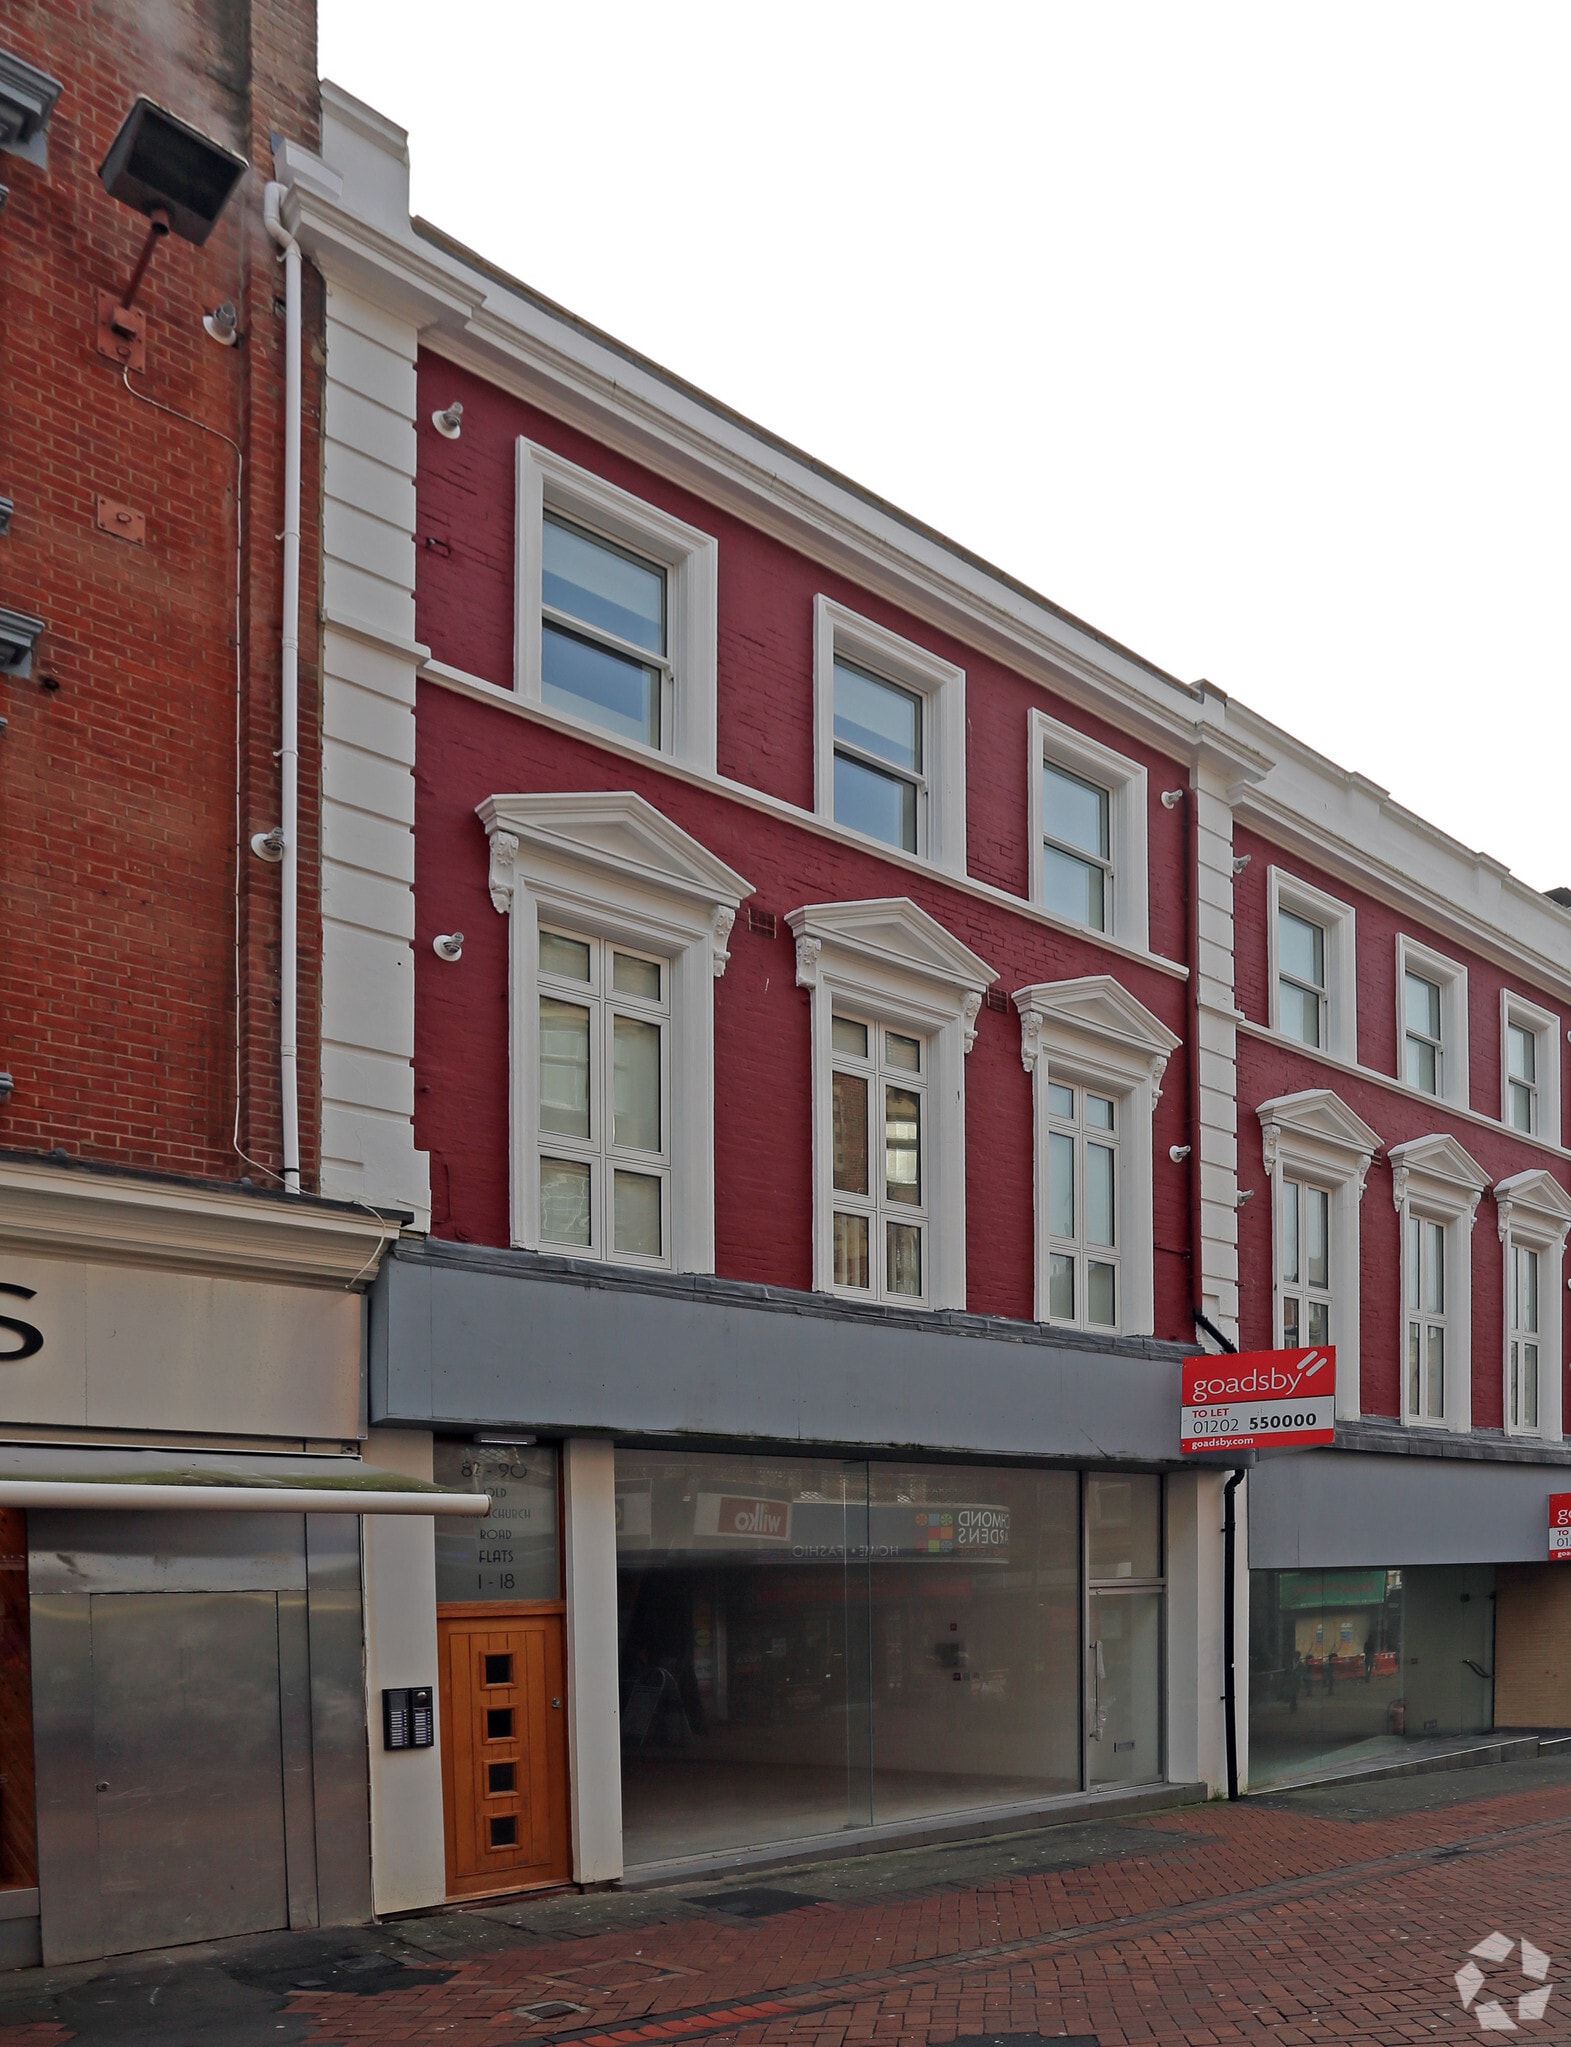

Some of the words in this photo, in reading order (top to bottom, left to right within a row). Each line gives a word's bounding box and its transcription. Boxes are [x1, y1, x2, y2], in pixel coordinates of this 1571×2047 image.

[1192, 1367, 1303, 1403] goadsby
[1192, 1410, 1208, 1419] TO
[1211, 1408, 1230, 1417] LET
[1193, 1418, 1239, 1434] 01202
[1249, 1413, 1317, 1430] 550000
[1192, 1437, 1254, 1450] goadsby.com
[484, 1487, 507, 1498] OLD
[480, 1529, 512, 1540] ROAD
[479, 1550, 514, 1563] FLATS
